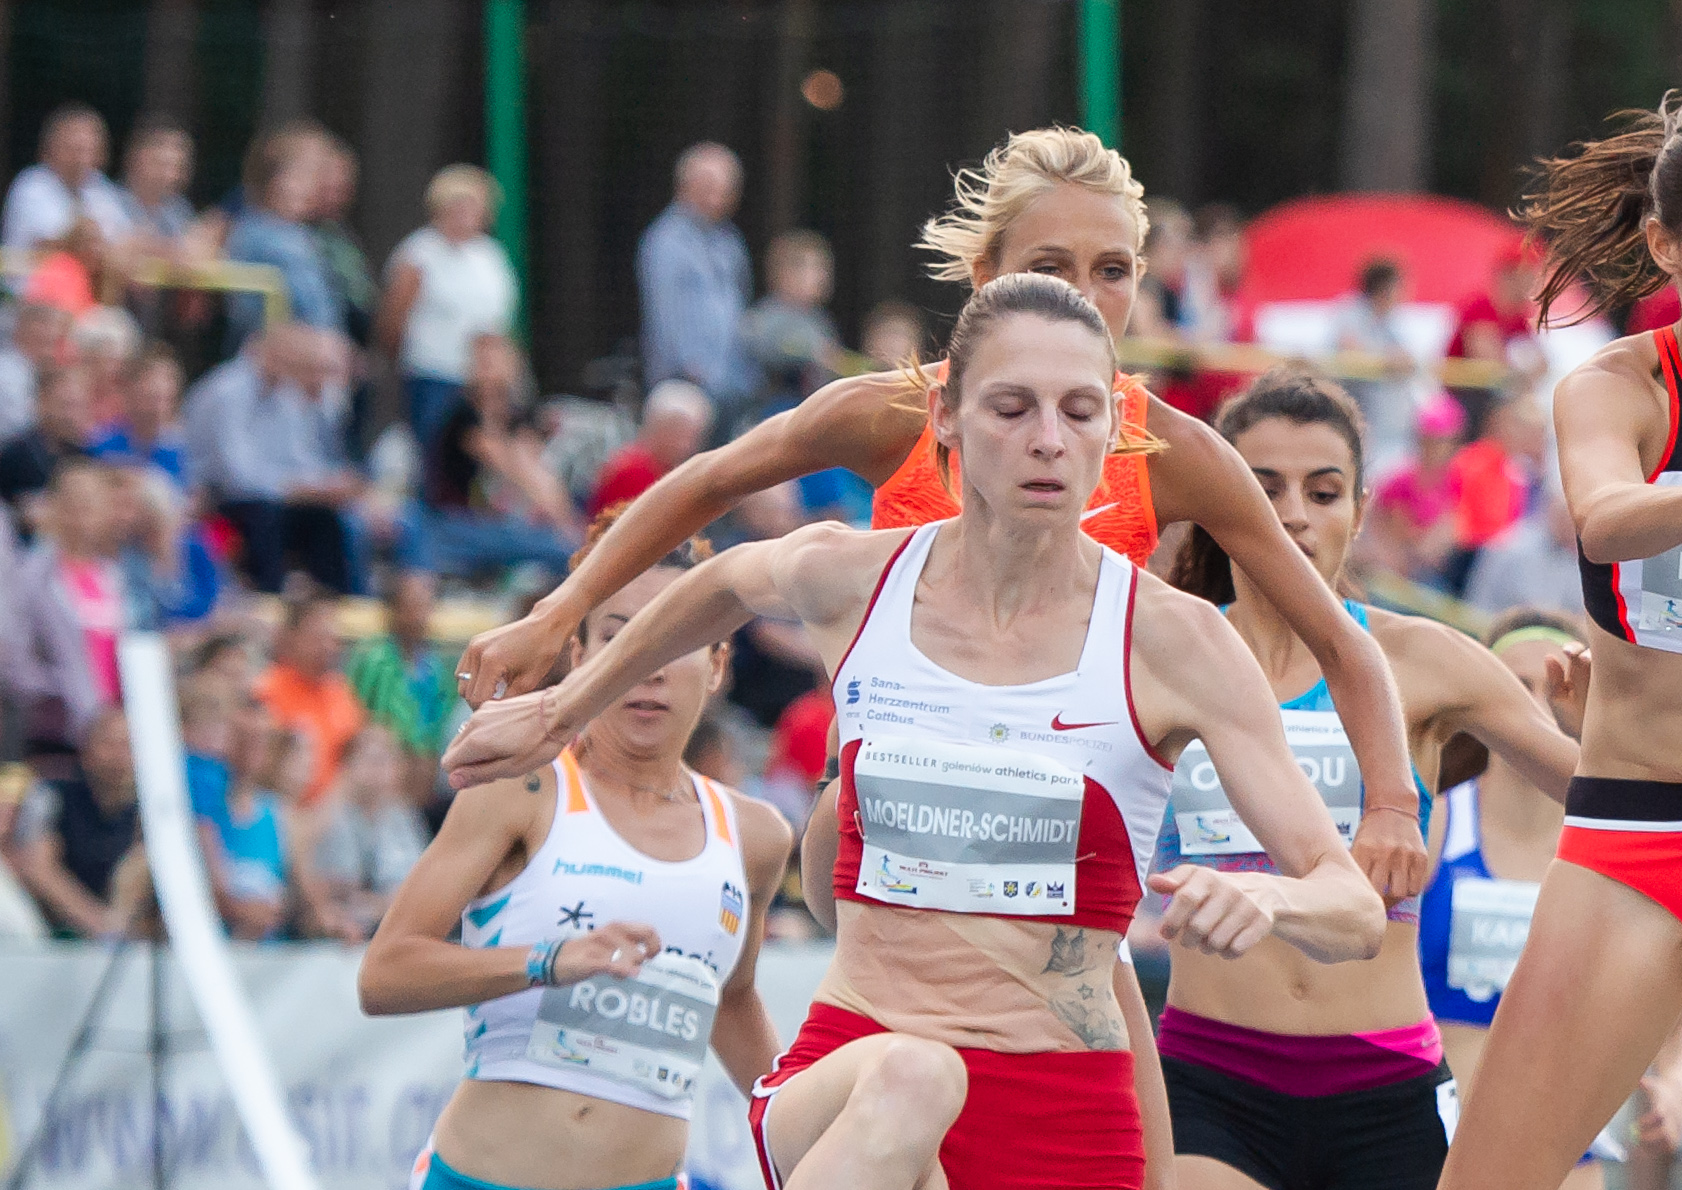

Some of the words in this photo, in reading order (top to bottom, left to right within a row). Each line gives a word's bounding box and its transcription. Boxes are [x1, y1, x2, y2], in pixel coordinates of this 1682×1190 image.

[871, 677, 906, 691] Sana-
[868, 693, 950, 714] Herzzentrum
[866, 709, 914, 725] Cottbus
[1019, 730, 1113, 752] BUNDESPOLIZEI
[865, 751, 938, 768] BESTSELLER
[941, 760, 992, 774] goleniów
[994, 765, 1047, 782] athletics
[1050, 773, 1079, 786] park
[865, 797, 1077, 843] MOELDNER-SCHMIDT
[552, 858, 644, 885] hummel
[569, 980, 698, 1041] ROBLES
